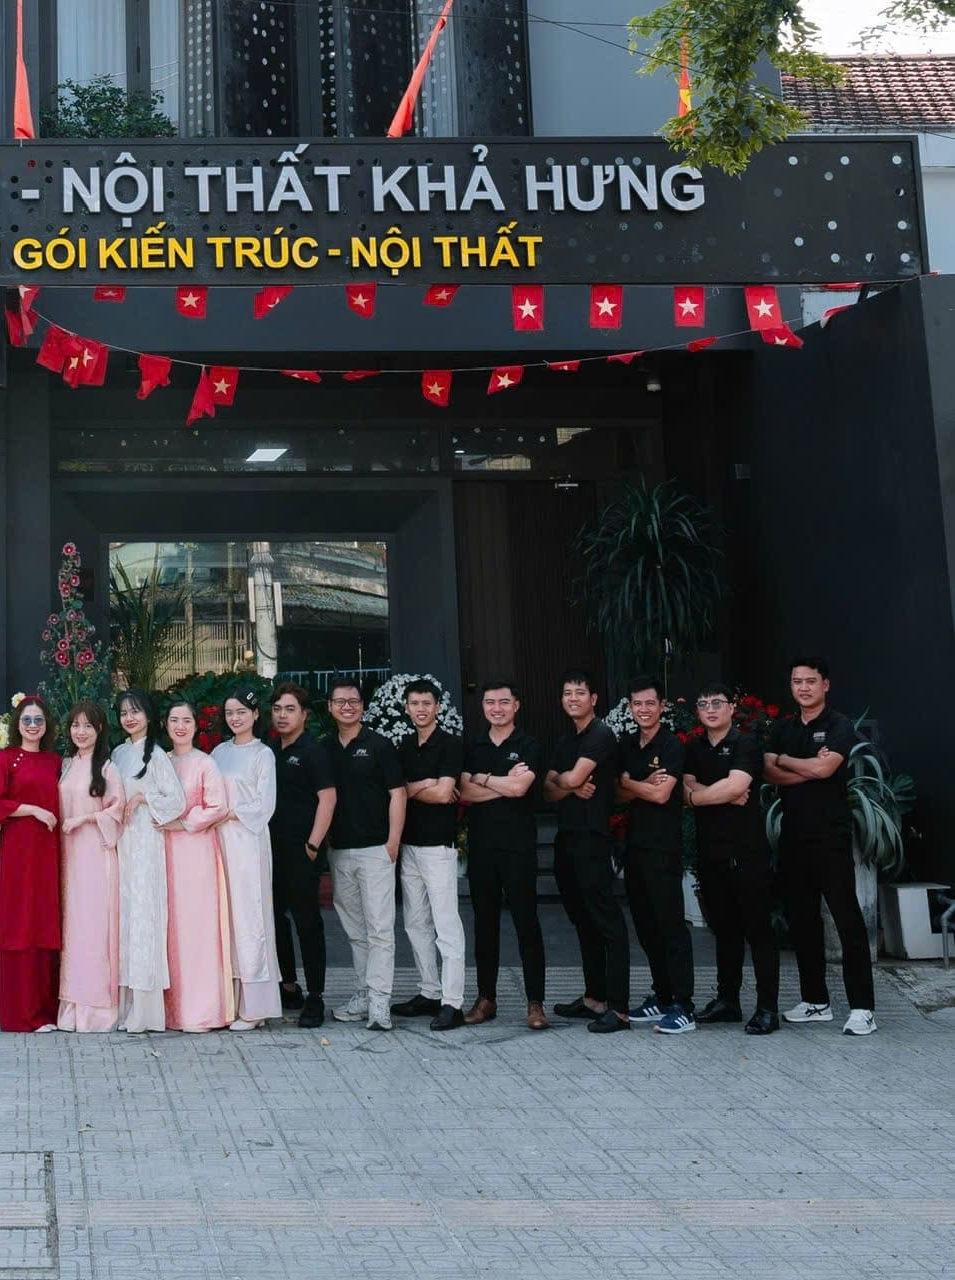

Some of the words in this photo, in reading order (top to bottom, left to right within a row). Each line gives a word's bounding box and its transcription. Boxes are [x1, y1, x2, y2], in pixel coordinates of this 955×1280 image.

[21, 189, 40, 200] -
[62, 152, 165, 228] NỘI
[184, 144, 351, 212] THẤT
[372, 144, 506, 213] KHẢ
[525, 163, 706, 212] HƯNG
[13, 227, 87, 270] GÓI
[98, 221, 194, 269] KIẾN
[206, 227, 320, 269] TRÚC
[327, 248, 342, 257] -
[351, 227, 422, 276] NỘI
[433, 221, 543, 268] THẤT
